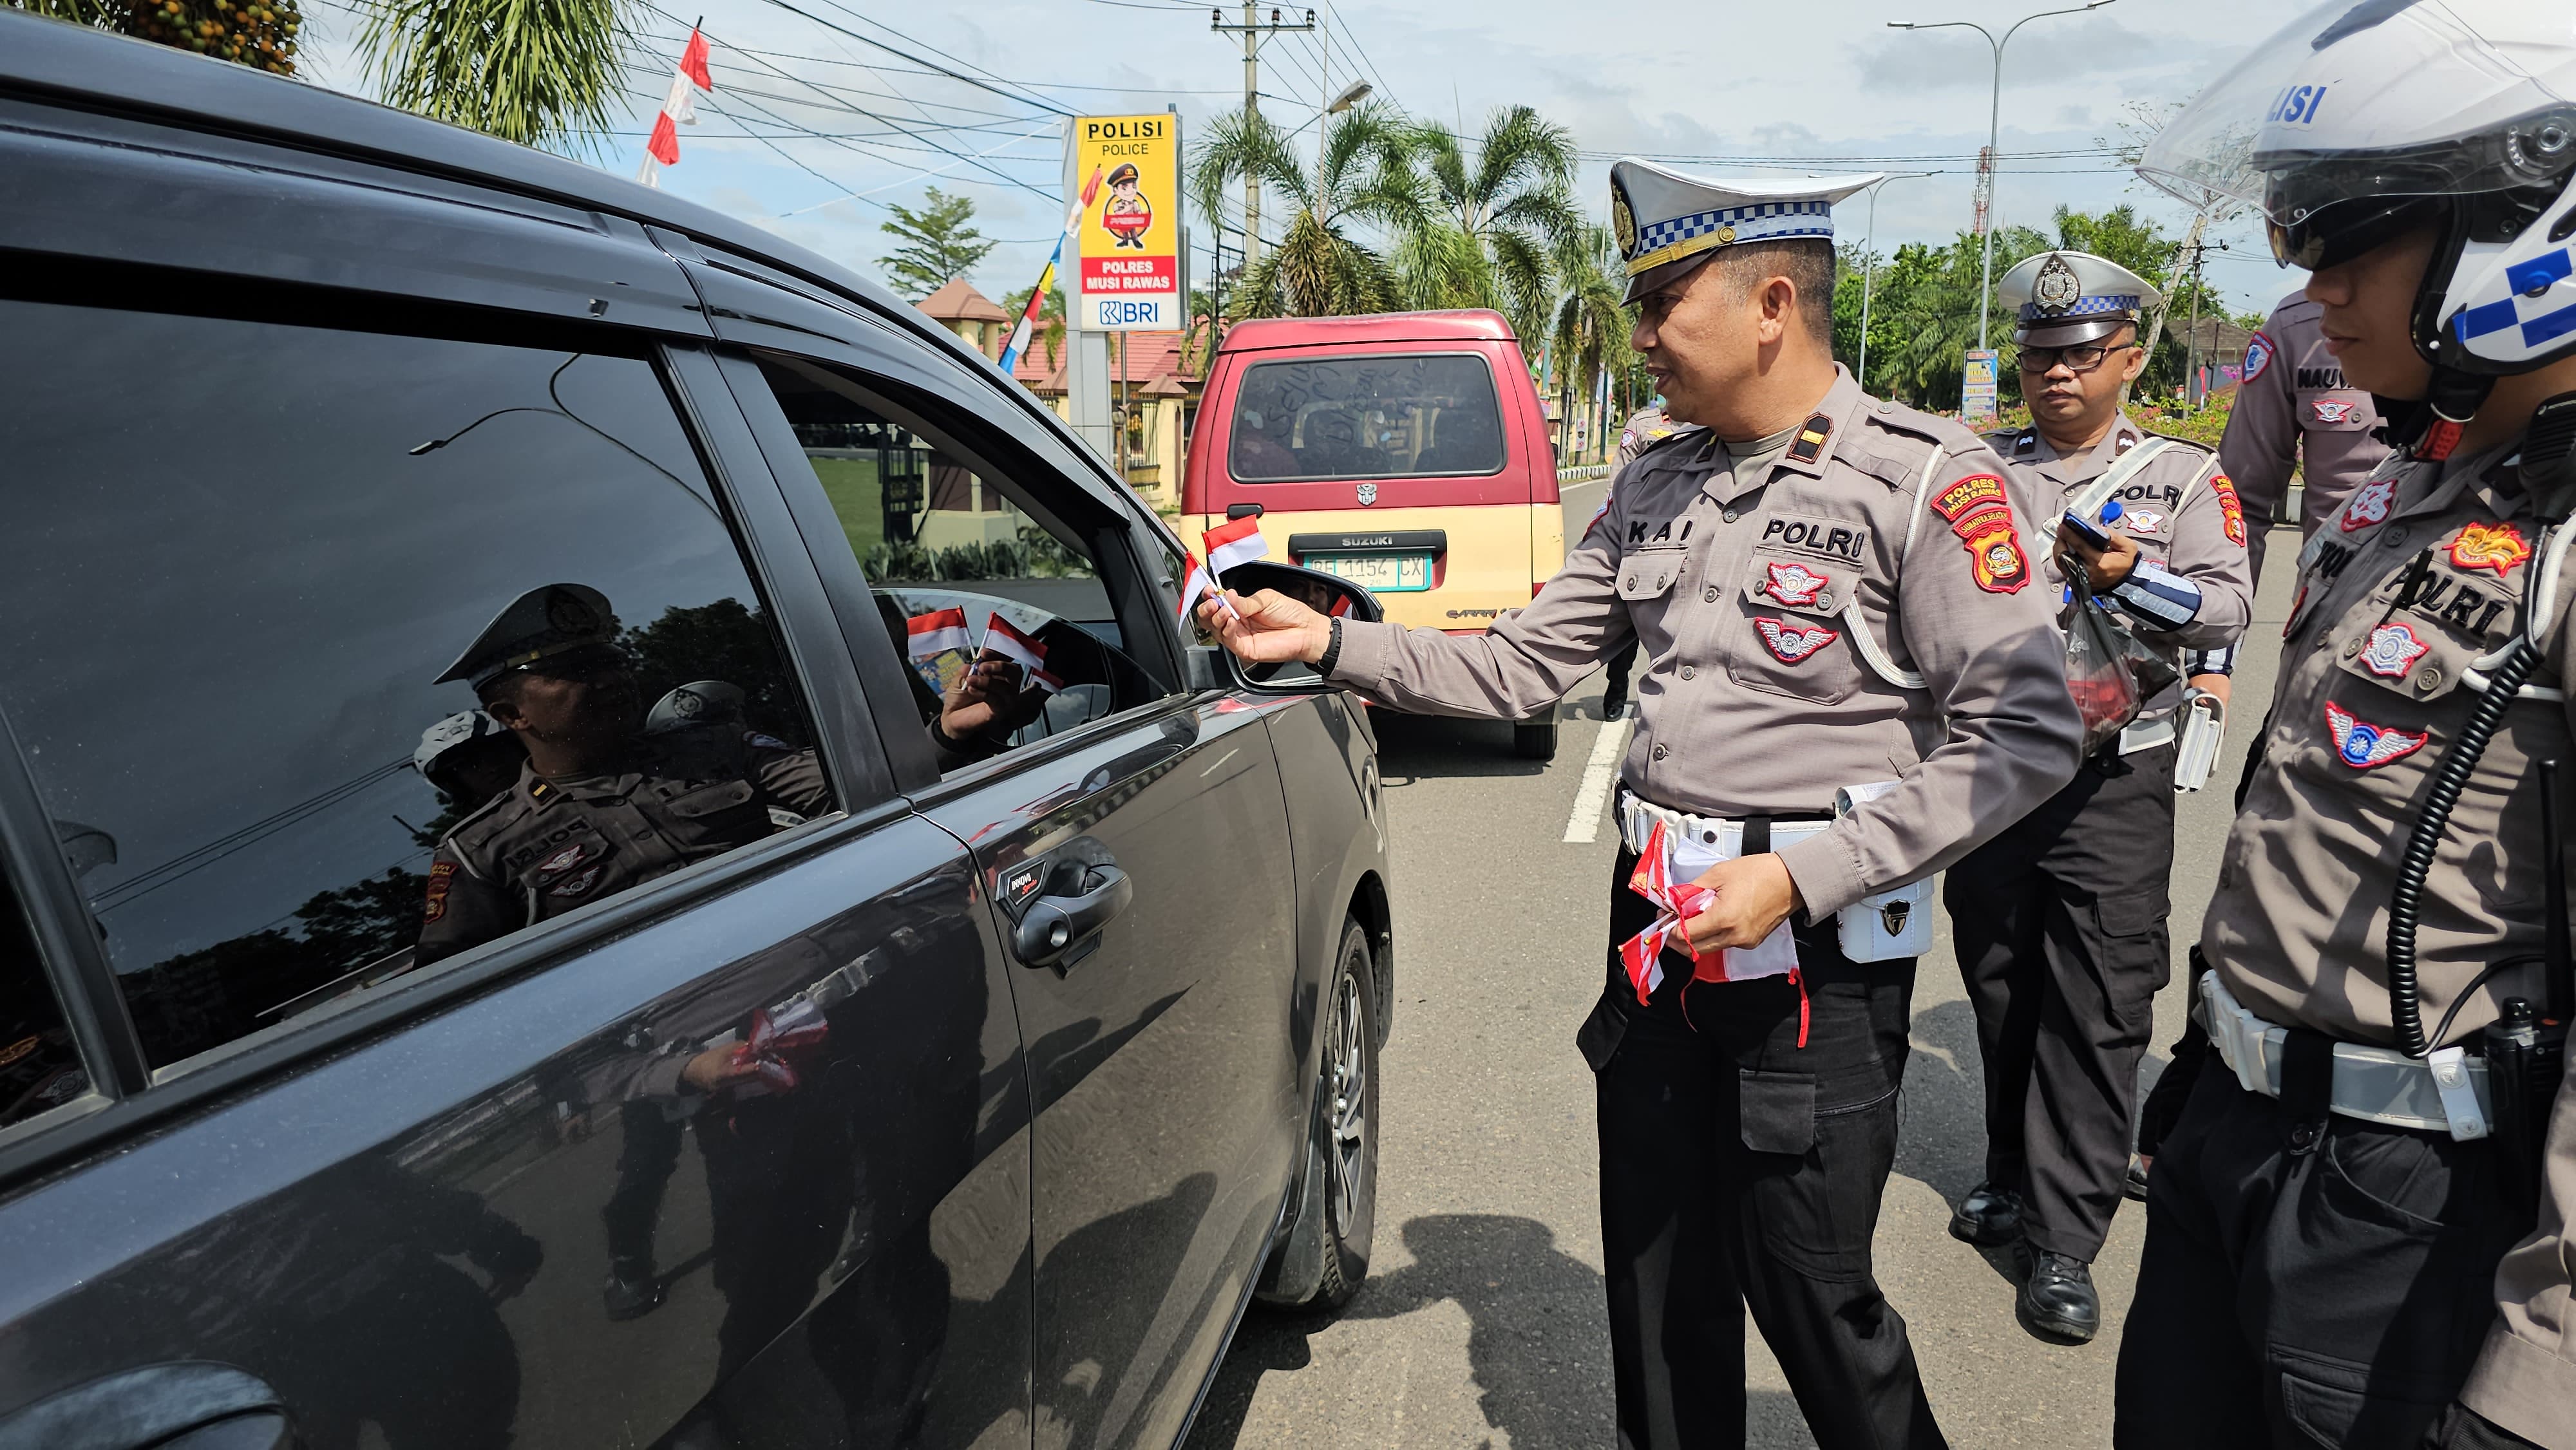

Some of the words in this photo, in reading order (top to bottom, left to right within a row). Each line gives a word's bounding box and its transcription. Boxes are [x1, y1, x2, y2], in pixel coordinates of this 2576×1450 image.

[1088, 121, 1162, 139] POLISI
[1102, 144, 1149, 156] POLICE
[1102, 261, 1153, 274] POLRES
[1086, 277, 1120, 290] MUSI
[1123, 276, 1170, 289] RAWAS
[1124, 303, 1158, 323] BRI
[1944, 479, 1996, 504] POLRES
[1947, 494, 1971, 514] MUSI
[1971, 489, 2001, 498] RAWAS
[1342, 536, 1392, 547] SUZUKI
[1762, 518, 1864, 558] POLRI
[1345, 558, 1387, 578] 1154
[1400, 558, 1421, 576] CX
[1011, 872, 1032, 891] INNOVA
